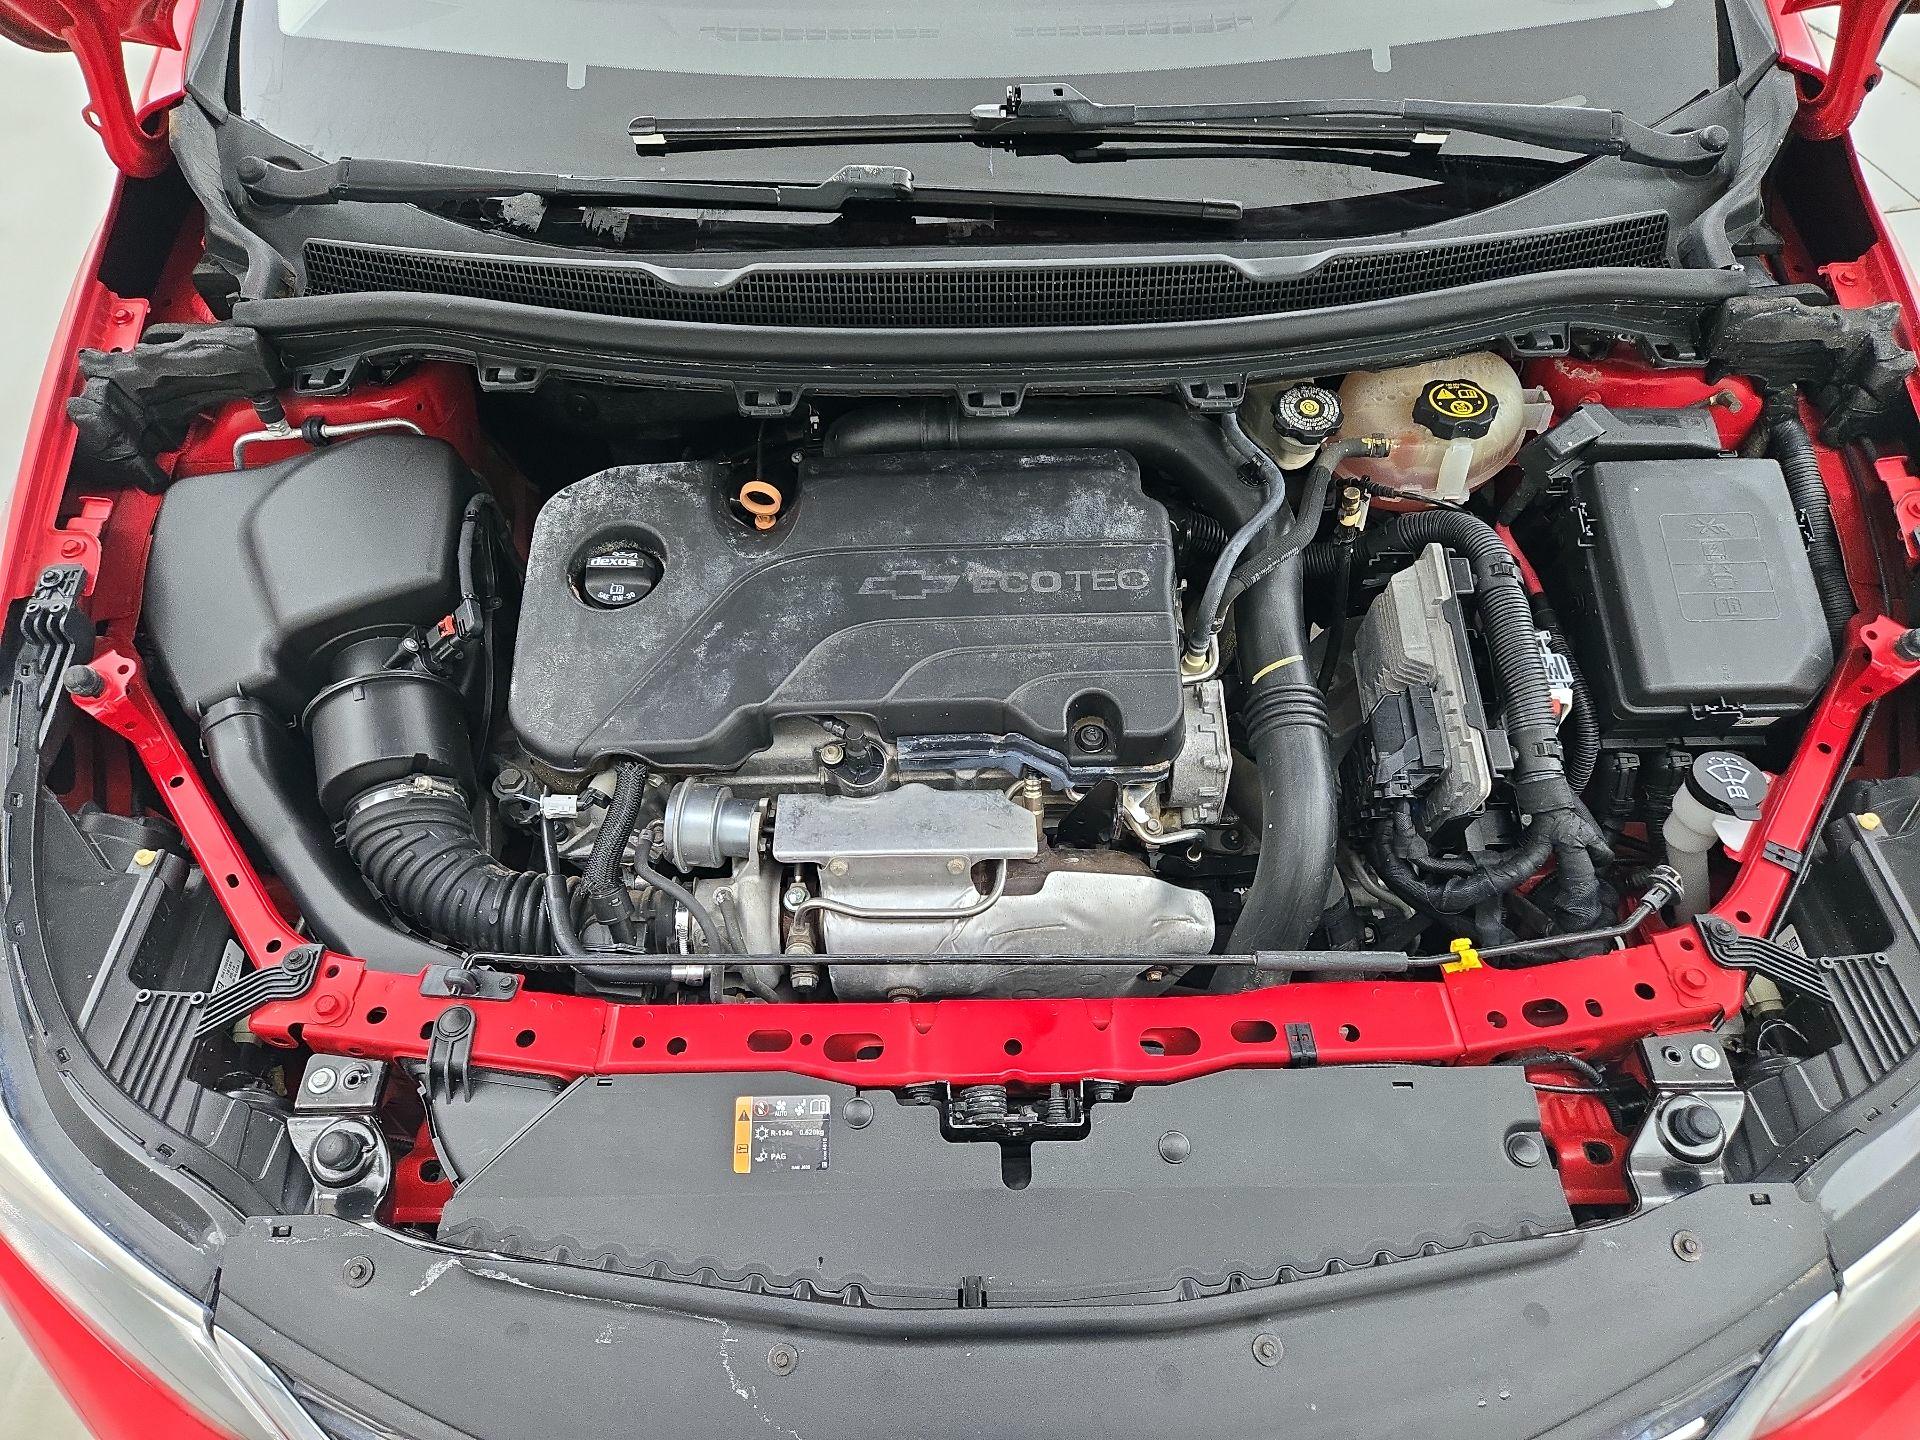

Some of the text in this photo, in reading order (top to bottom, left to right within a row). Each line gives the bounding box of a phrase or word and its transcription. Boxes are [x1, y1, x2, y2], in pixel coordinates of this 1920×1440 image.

[590, 557, 637, 566] dexos
[972, 568, 1150, 593] ECOTEC
[597, 592, 635, 601] SAE 5W-30
